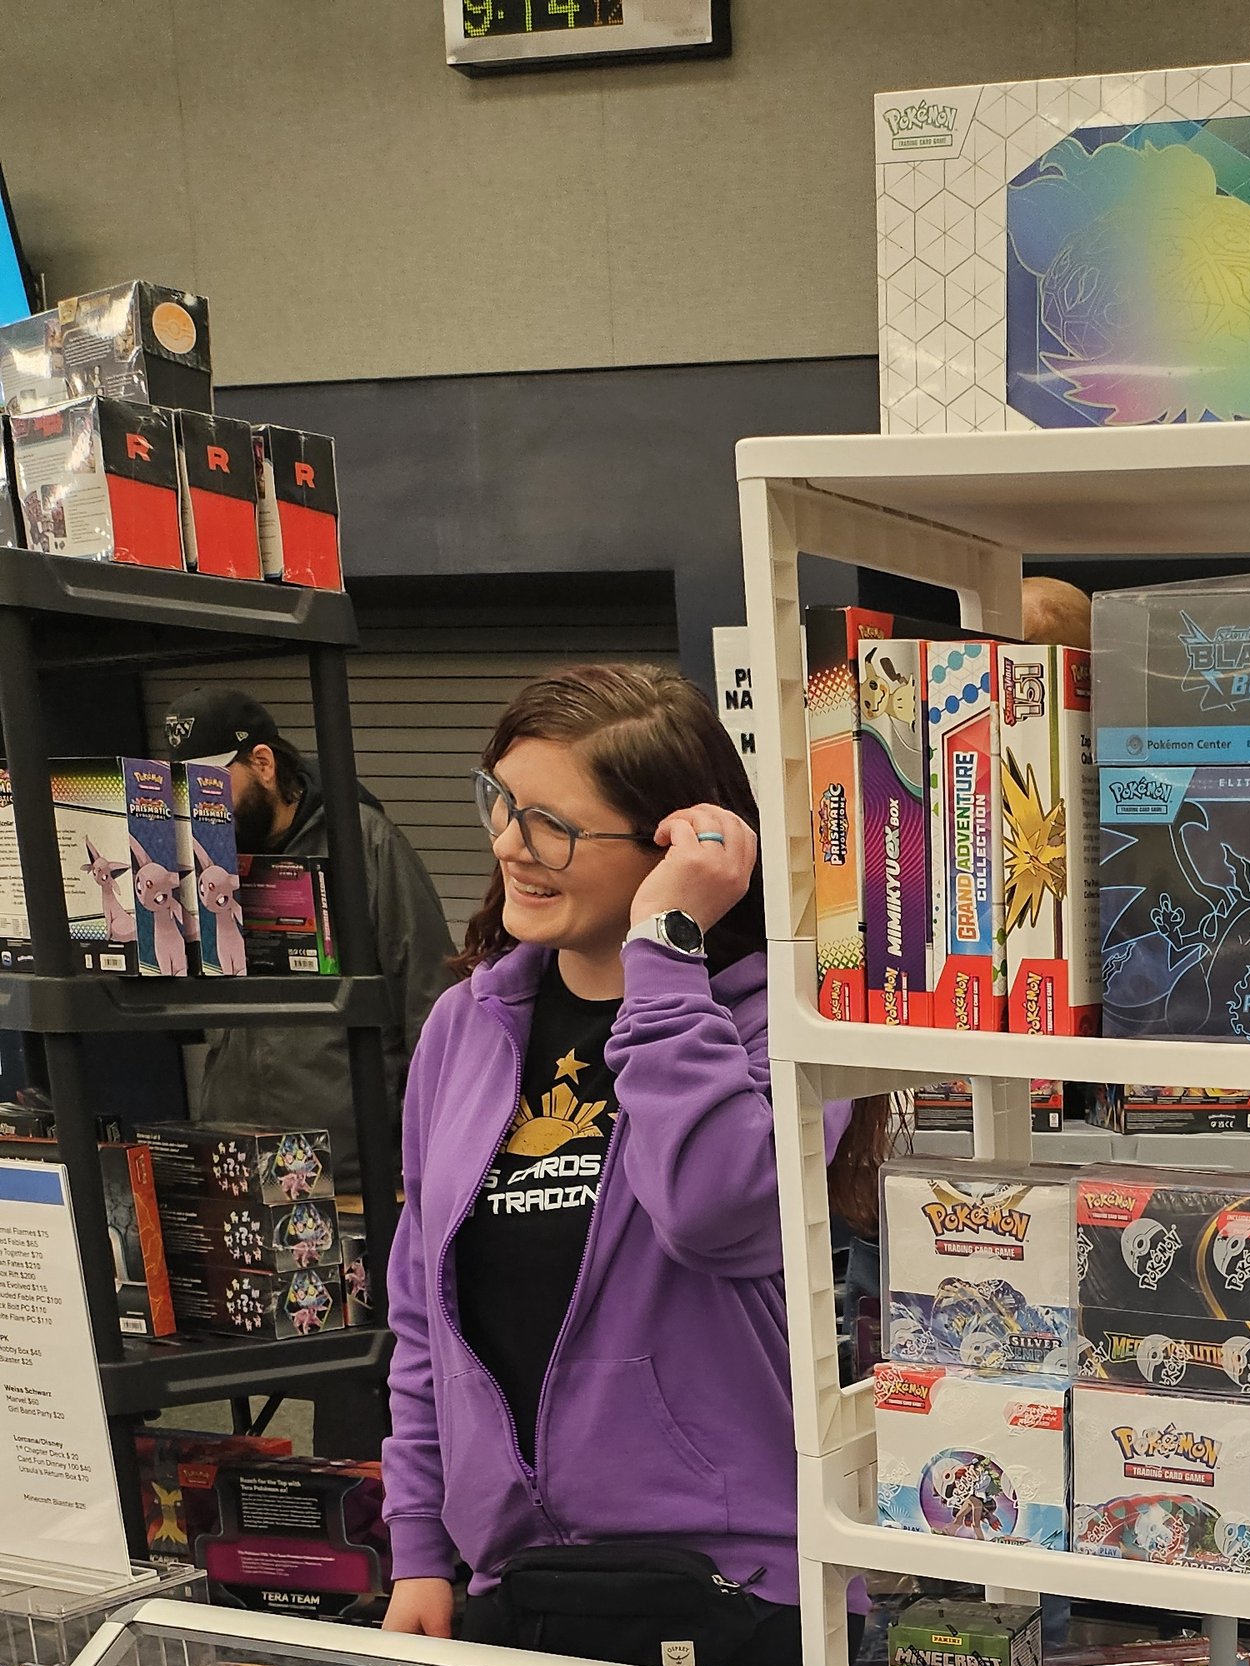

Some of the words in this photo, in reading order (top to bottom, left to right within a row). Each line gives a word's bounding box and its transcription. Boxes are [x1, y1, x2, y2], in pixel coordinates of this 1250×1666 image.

[126, 433, 151, 461] R
[207, 445, 230, 473] R
[294, 462, 316, 488] R
[1014, 662, 1044, 722] 151
[1147, 738, 1194, 751] Pokémon
[1197, 738, 1232, 751] Center
[130, 803, 171, 818] PRISMATIC
[193, 807, 232, 823] PRISMATIC
[889, 798, 900, 827] BOX
[954, 753, 977, 868] ADVENTURE
[830, 783, 843, 866] PRISMATIC
[976, 793, 986, 902] COLLECTION
[887, 860, 902, 957] MIMIKYU
[957, 872, 976, 940] GRAND
[507, 1155, 601, 1185] CARDS
[487, 1183, 600, 1214] TRADIN
[944, 1243, 973, 1254] TRADING
[994, 1247, 1015, 1257] GAME
[17, 1294, 34, 1302] Fable
[47, 1297, 62, 1305] $100
[1011, 1335, 1061, 1348] SILVER
[4, 1384, 24, 1394] Weiss
[24, 1387, 52, 1397] Schwarz
[20, 1406, 36, 1415] Band
[37, 1409, 52, 1419] Party
[44, 1469, 64, 1478] Return
[65, 1472, 77, 1480] Box
[1133, 1467, 1163, 1478] TRADING
[1164, 1470, 1183, 1480] CARD
[1184, 1472, 1206, 1483] GAME
[1100, 1547, 1117, 1556] PLAY
[261, 1591, 289, 1602] TERA
[291, 1592, 320, 1605] TEAM
[934, 1636, 961, 1644] PANINI
